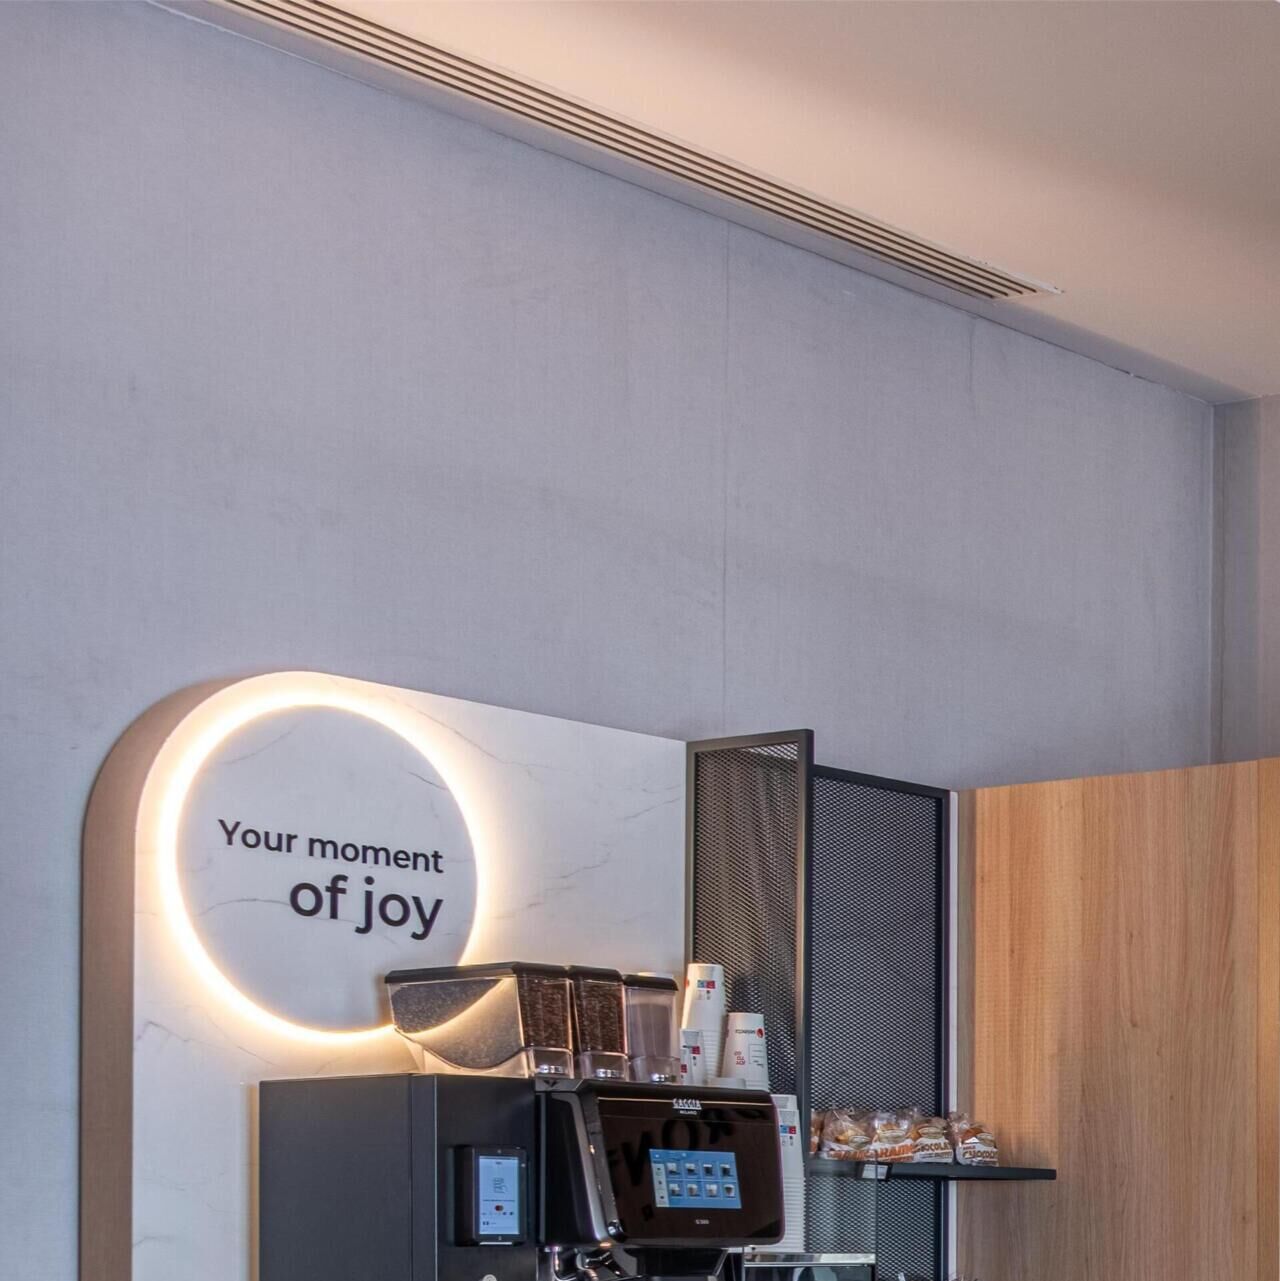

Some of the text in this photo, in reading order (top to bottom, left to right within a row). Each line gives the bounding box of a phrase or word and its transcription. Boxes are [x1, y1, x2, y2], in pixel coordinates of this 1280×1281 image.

[218, 819, 444, 873] Your moment
[290, 874, 443, 940] of joy
